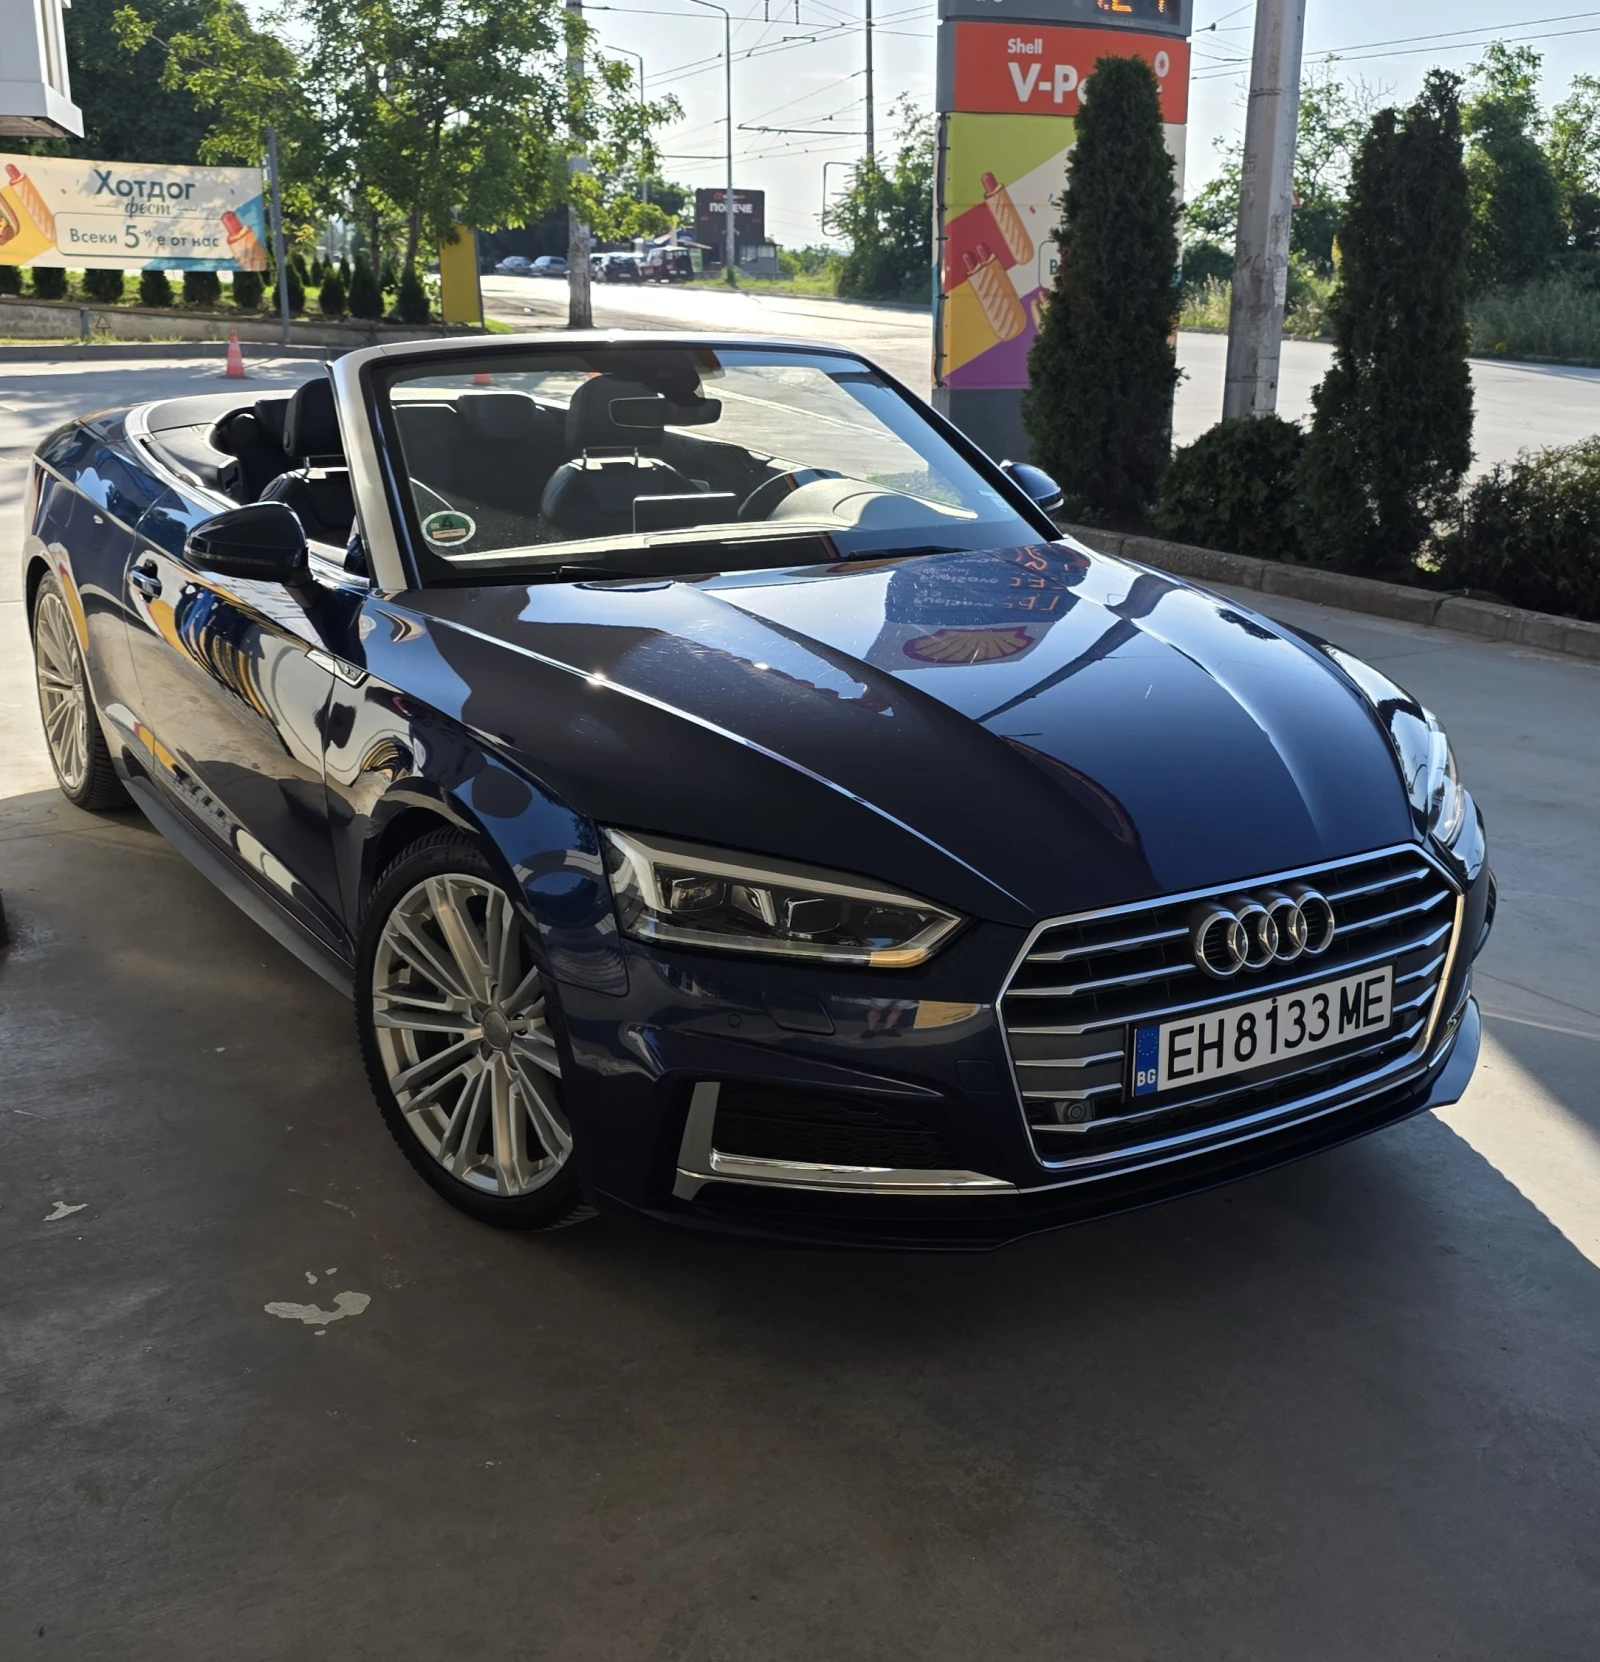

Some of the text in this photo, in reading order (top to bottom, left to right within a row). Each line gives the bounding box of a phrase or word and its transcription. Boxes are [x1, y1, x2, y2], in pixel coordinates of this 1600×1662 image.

[1007, 37, 1043, 54] Shell
[93, 168, 197, 202] Хотдог
[125, 196, 172, 219] фест
[709, 202, 753, 213] ПОЕЧЕ
[70, 228, 118, 245] Всеки
[157, 235, 166, 246] е
[171, 236, 188, 247] от
[192, 236, 219, 248] нас
[1136, 1068, 1157, 1087] BG
